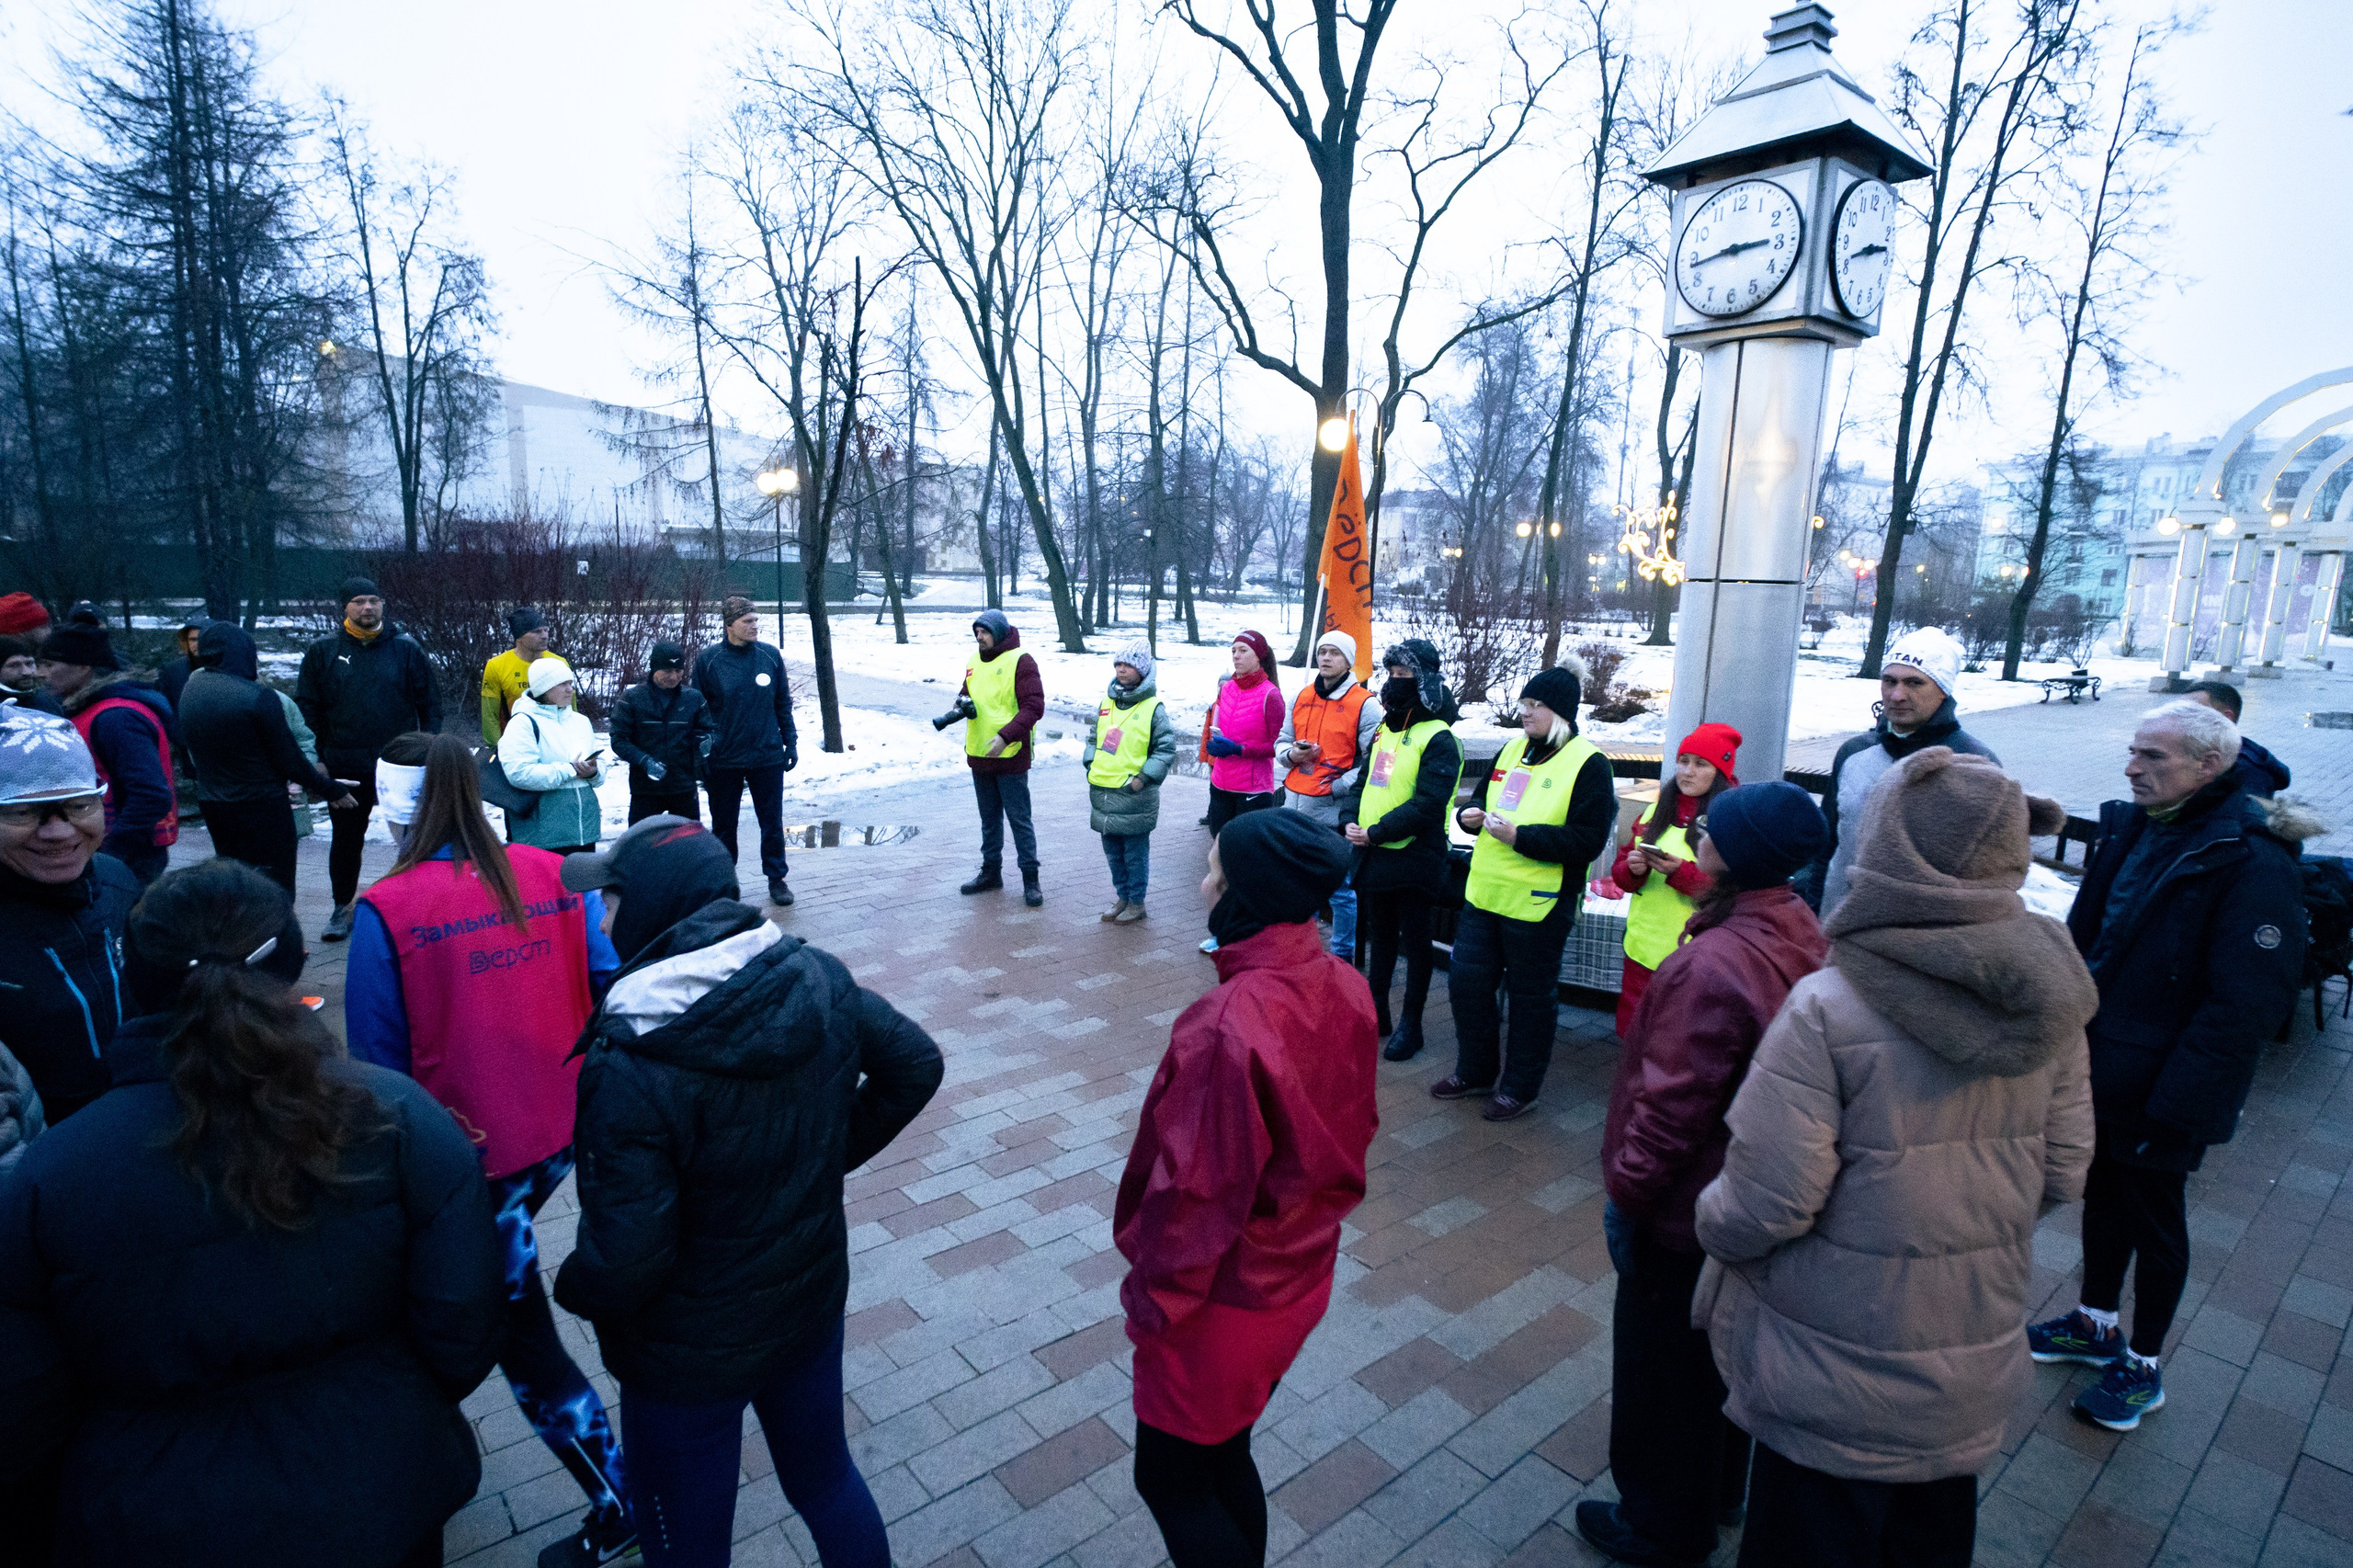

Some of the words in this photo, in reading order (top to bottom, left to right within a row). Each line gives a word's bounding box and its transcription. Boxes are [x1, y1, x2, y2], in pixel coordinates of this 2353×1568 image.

[1733, 194, 1748, 212] 12
[1757, 197, 1764, 213] 1
[1859, 196, 1868, 213] 11
[1870, 194, 1880, 211] 12
[1713, 206, 1724, 222] 11
[1770, 210, 1781, 228] 2
[1847, 210, 1858, 228] 10
[1881, 206, 1886, 222] 1
[1695, 226, 1710, 243] 10
[1774, 233, 1785, 250] 3
[1843, 233, 1849, 251] 9
[1884, 225, 1892, 242] 2
[1690, 251, 1699, 267] 9
[1766, 258, 1775, 274] 4
[1882, 249, 1889, 267] 3
[1842, 258, 1850, 276] 8
[1692, 271, 1702, 288] 8
[1748, 278, 1758, 295] 5
[1847, 278, 1854, 296] 7
[1877, 273, 1882, 289] 4
[1707, 286, 1715, 302] 7
[1726, 288, 1736, 304] 6
[1857, 289, 1863, 305] 6
[1867, 287, 1873, 303] 5
[411, 892, 579, 949] Замыкщий
